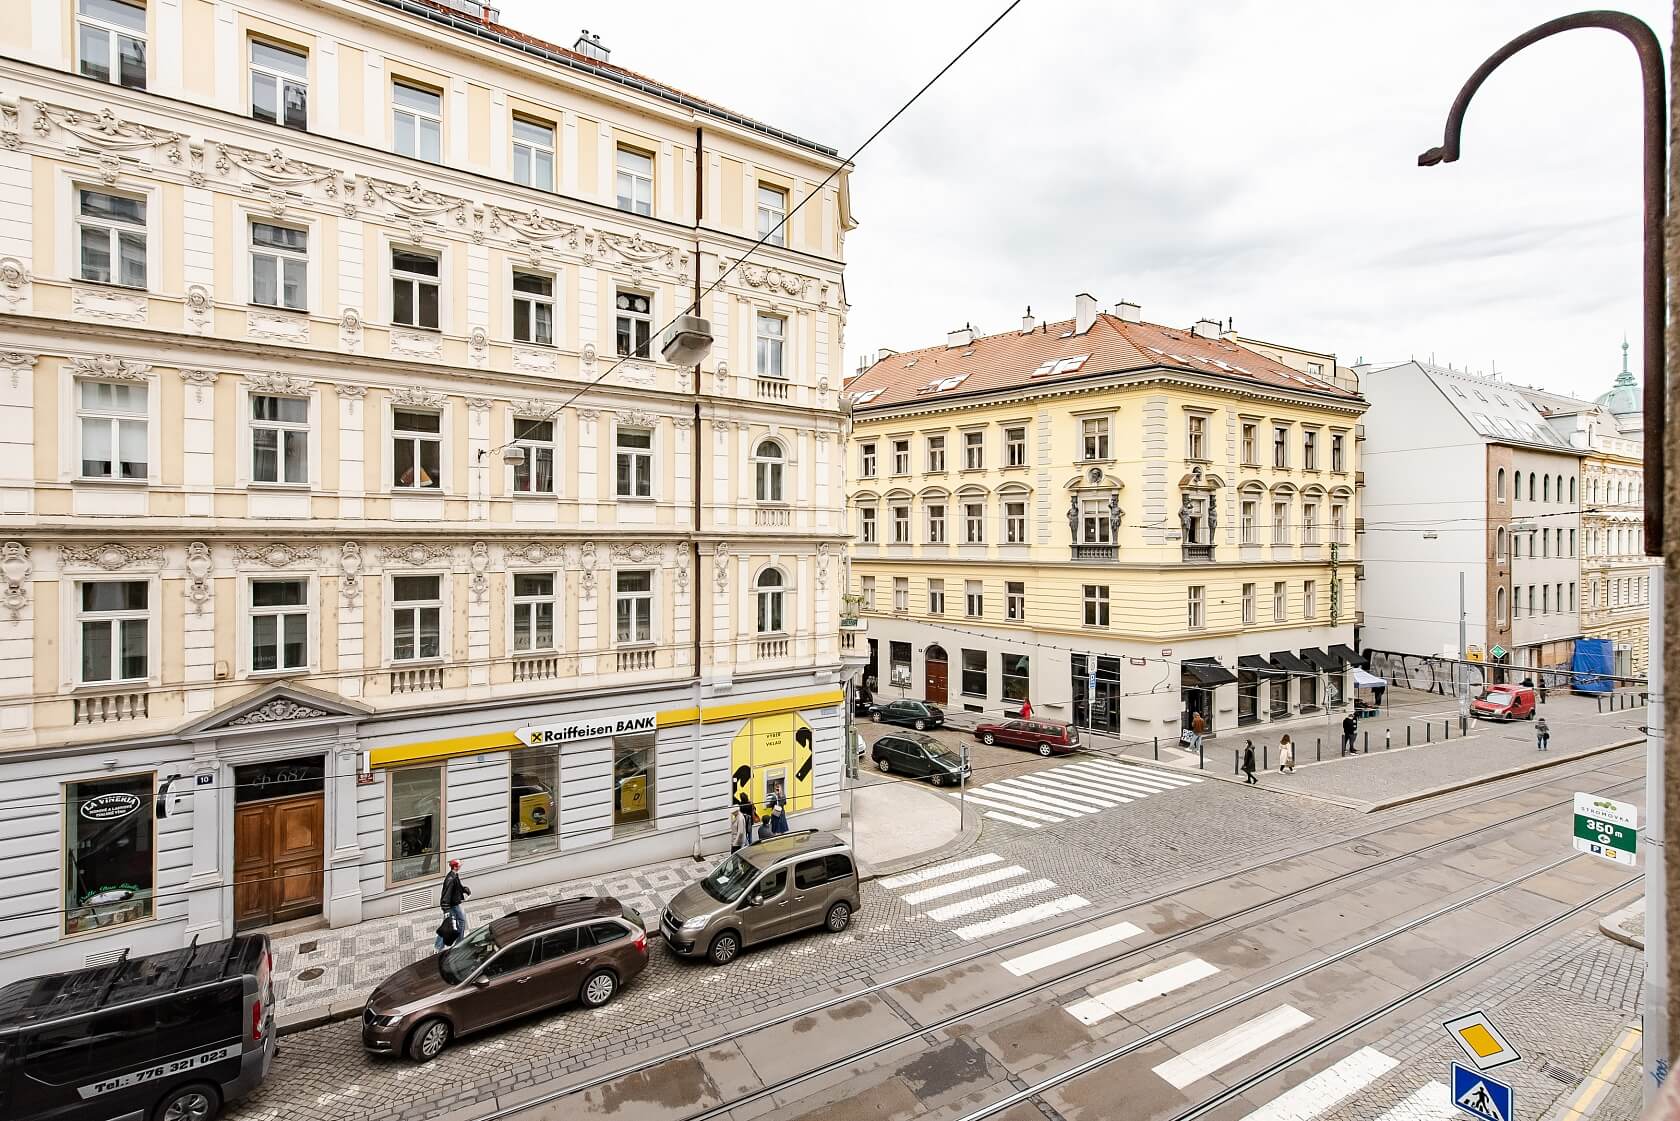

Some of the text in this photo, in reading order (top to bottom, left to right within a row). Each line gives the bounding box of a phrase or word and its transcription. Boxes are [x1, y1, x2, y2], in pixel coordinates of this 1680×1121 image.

[544, 716, 655, 742] Raiffeisen BANK
[200, 776, 209, 784] 10
[84, 801, 98, 811] LA
[98, 795, 136, 805] VINERIA
[1581, 806, 1630, 822] STROMOVKA
[1586, 819, 1613, 835] 350
[95, 1049, 227, 1093] Tel.: 776 321 023
